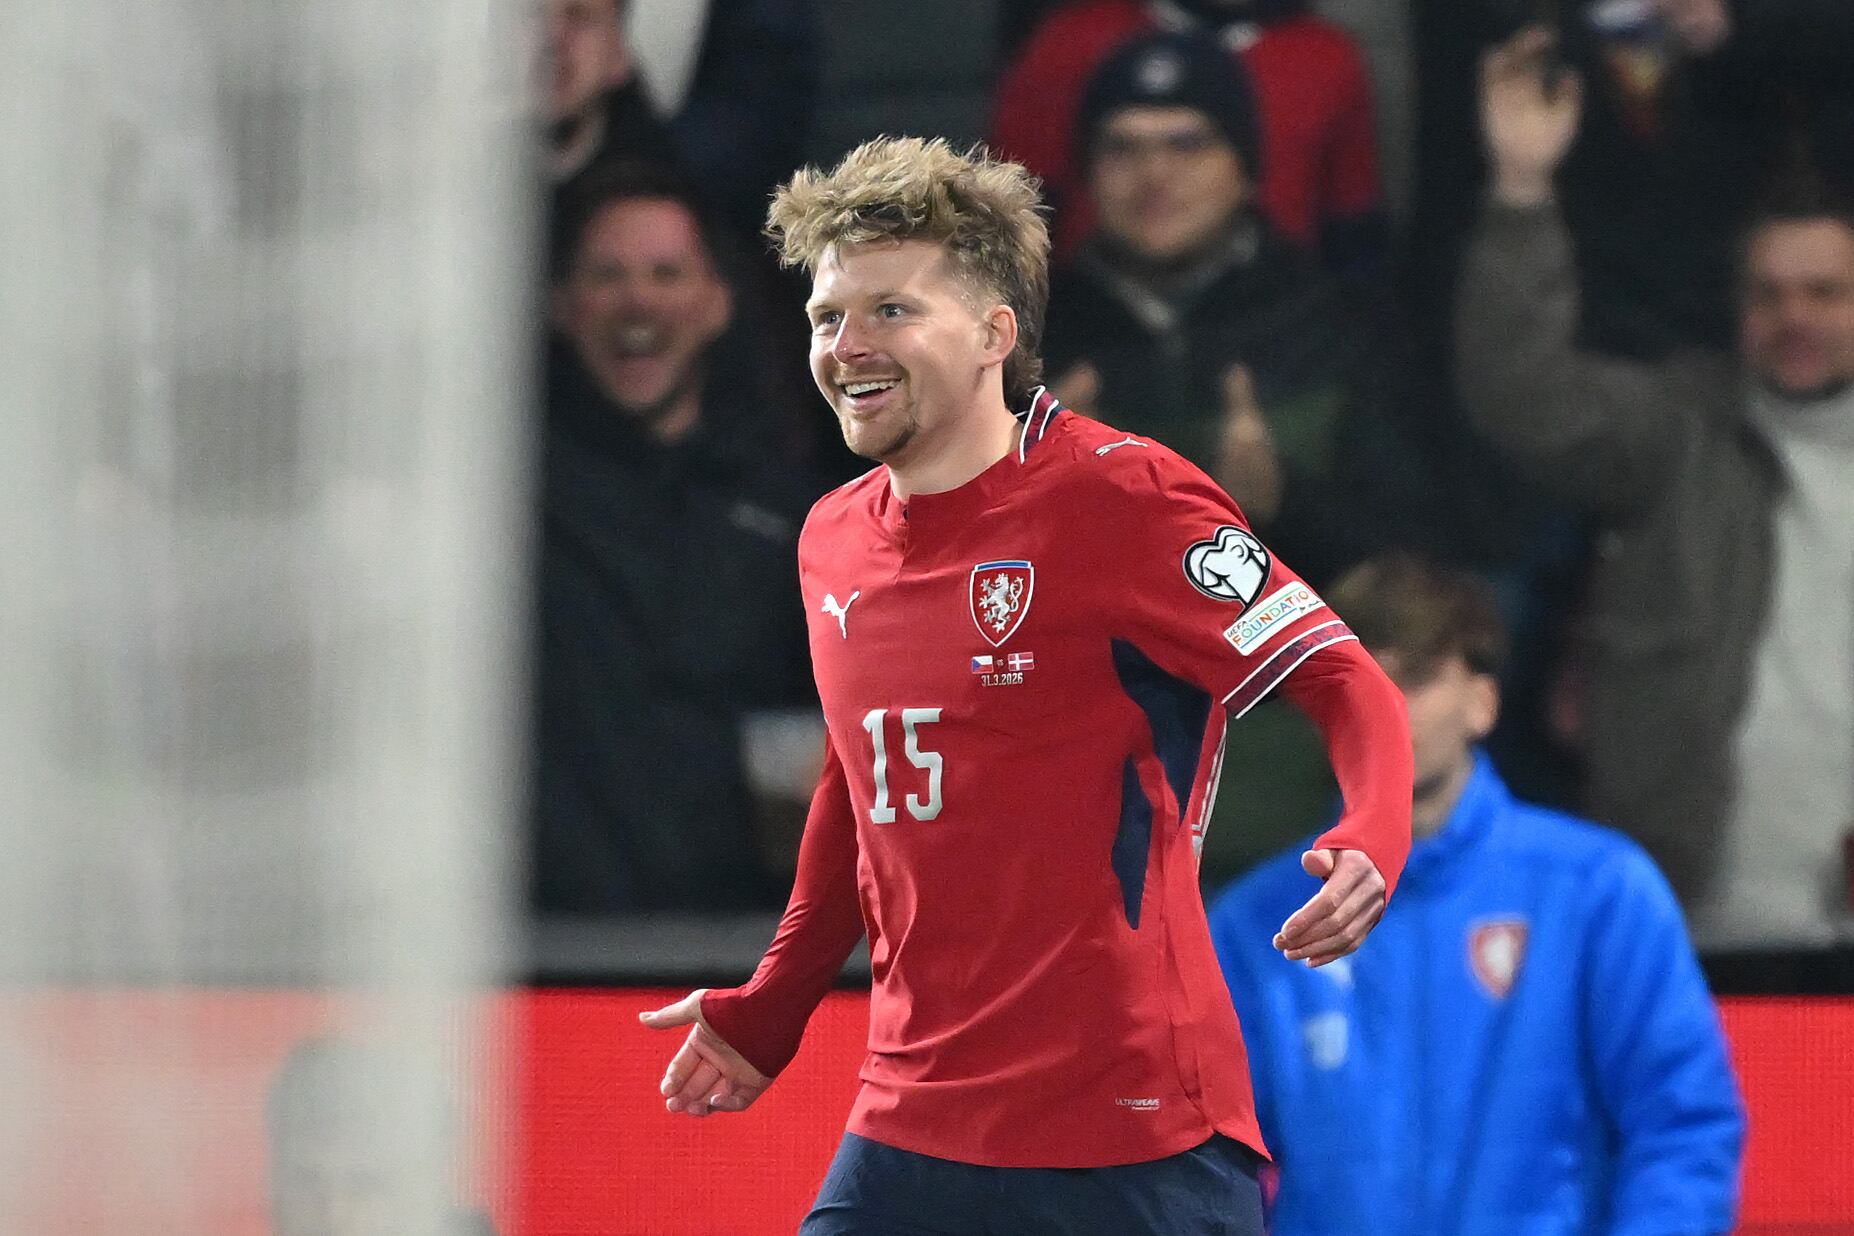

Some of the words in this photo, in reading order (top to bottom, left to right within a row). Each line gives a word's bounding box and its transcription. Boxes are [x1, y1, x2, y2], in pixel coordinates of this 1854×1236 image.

[1231, 590, 1311, 647] FOUNDATIO
[981, 672, 1024, 687] 31.3.2026
[862, 707, 944, 824] 15
